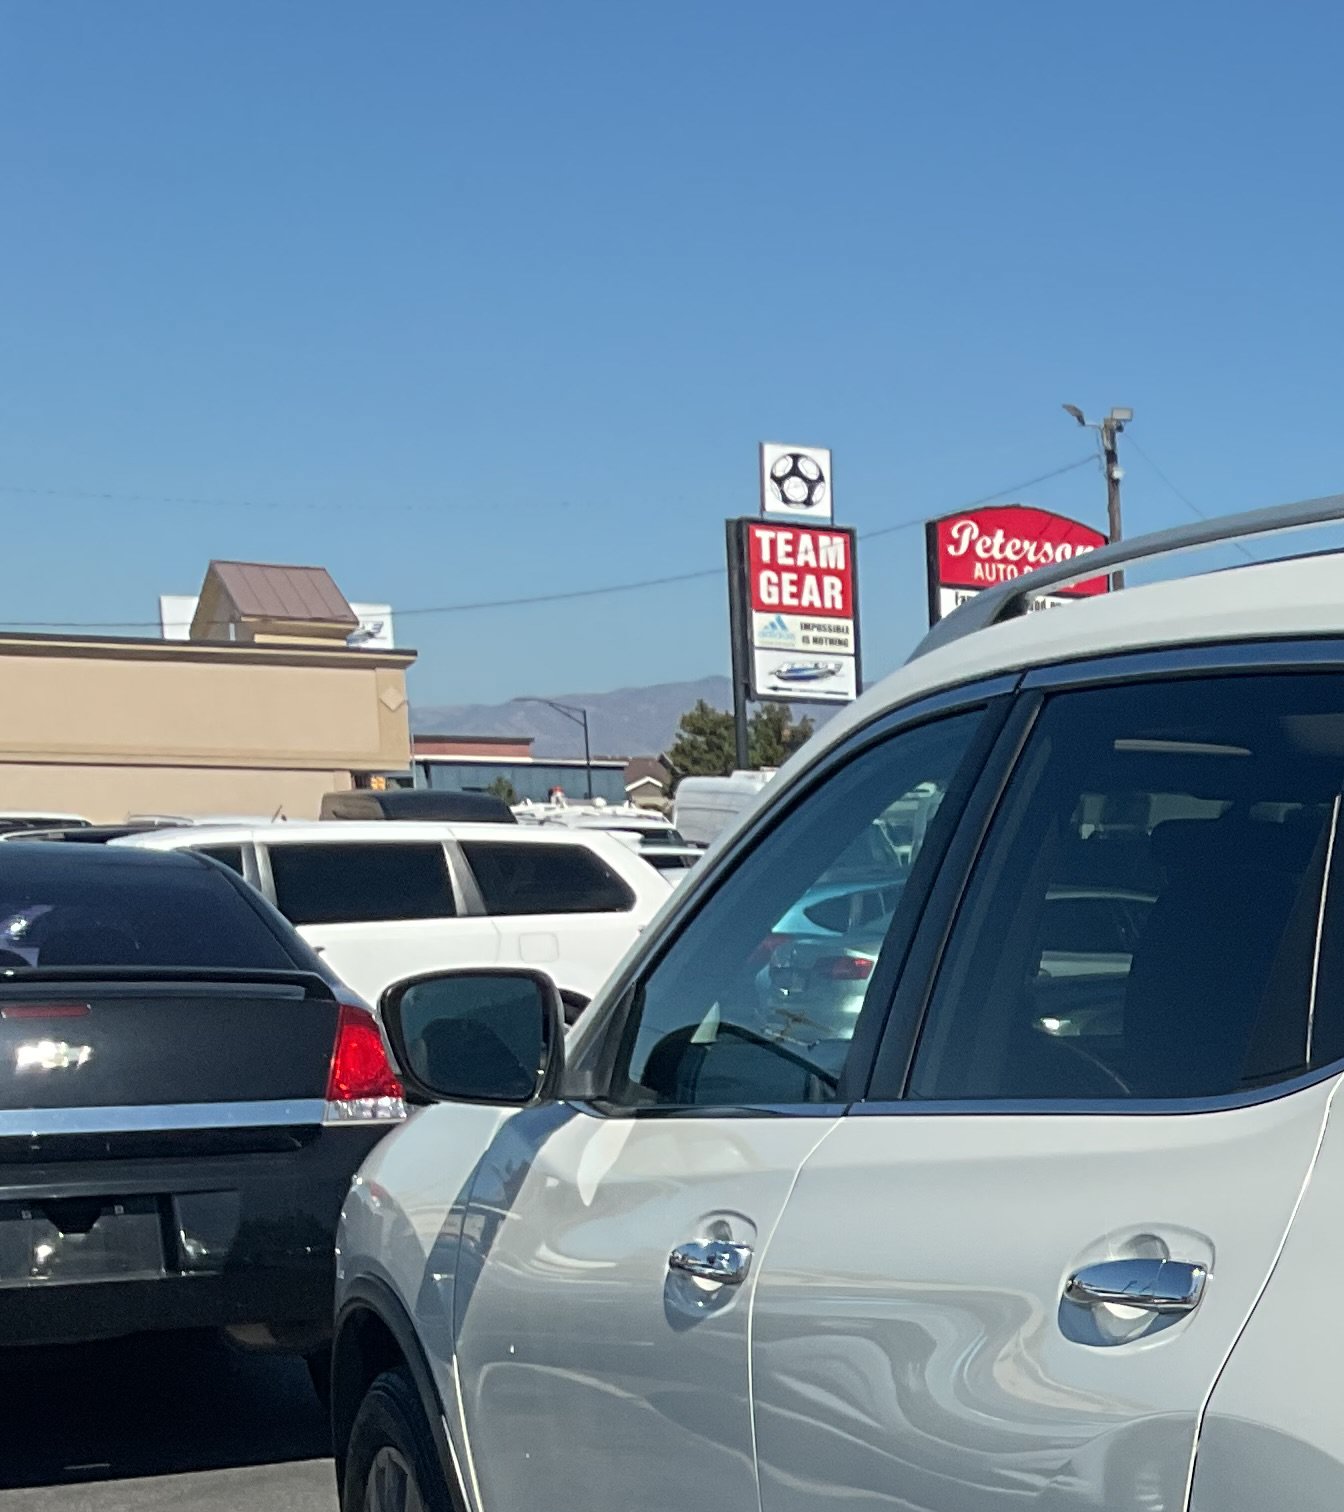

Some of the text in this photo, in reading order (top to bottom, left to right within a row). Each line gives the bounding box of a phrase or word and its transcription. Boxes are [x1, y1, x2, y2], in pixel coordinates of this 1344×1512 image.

[755, 529, 845, 570] TEAM
[759, 569, 843, 609] GEAR
[974, 562, 1019, 582] AUTO
